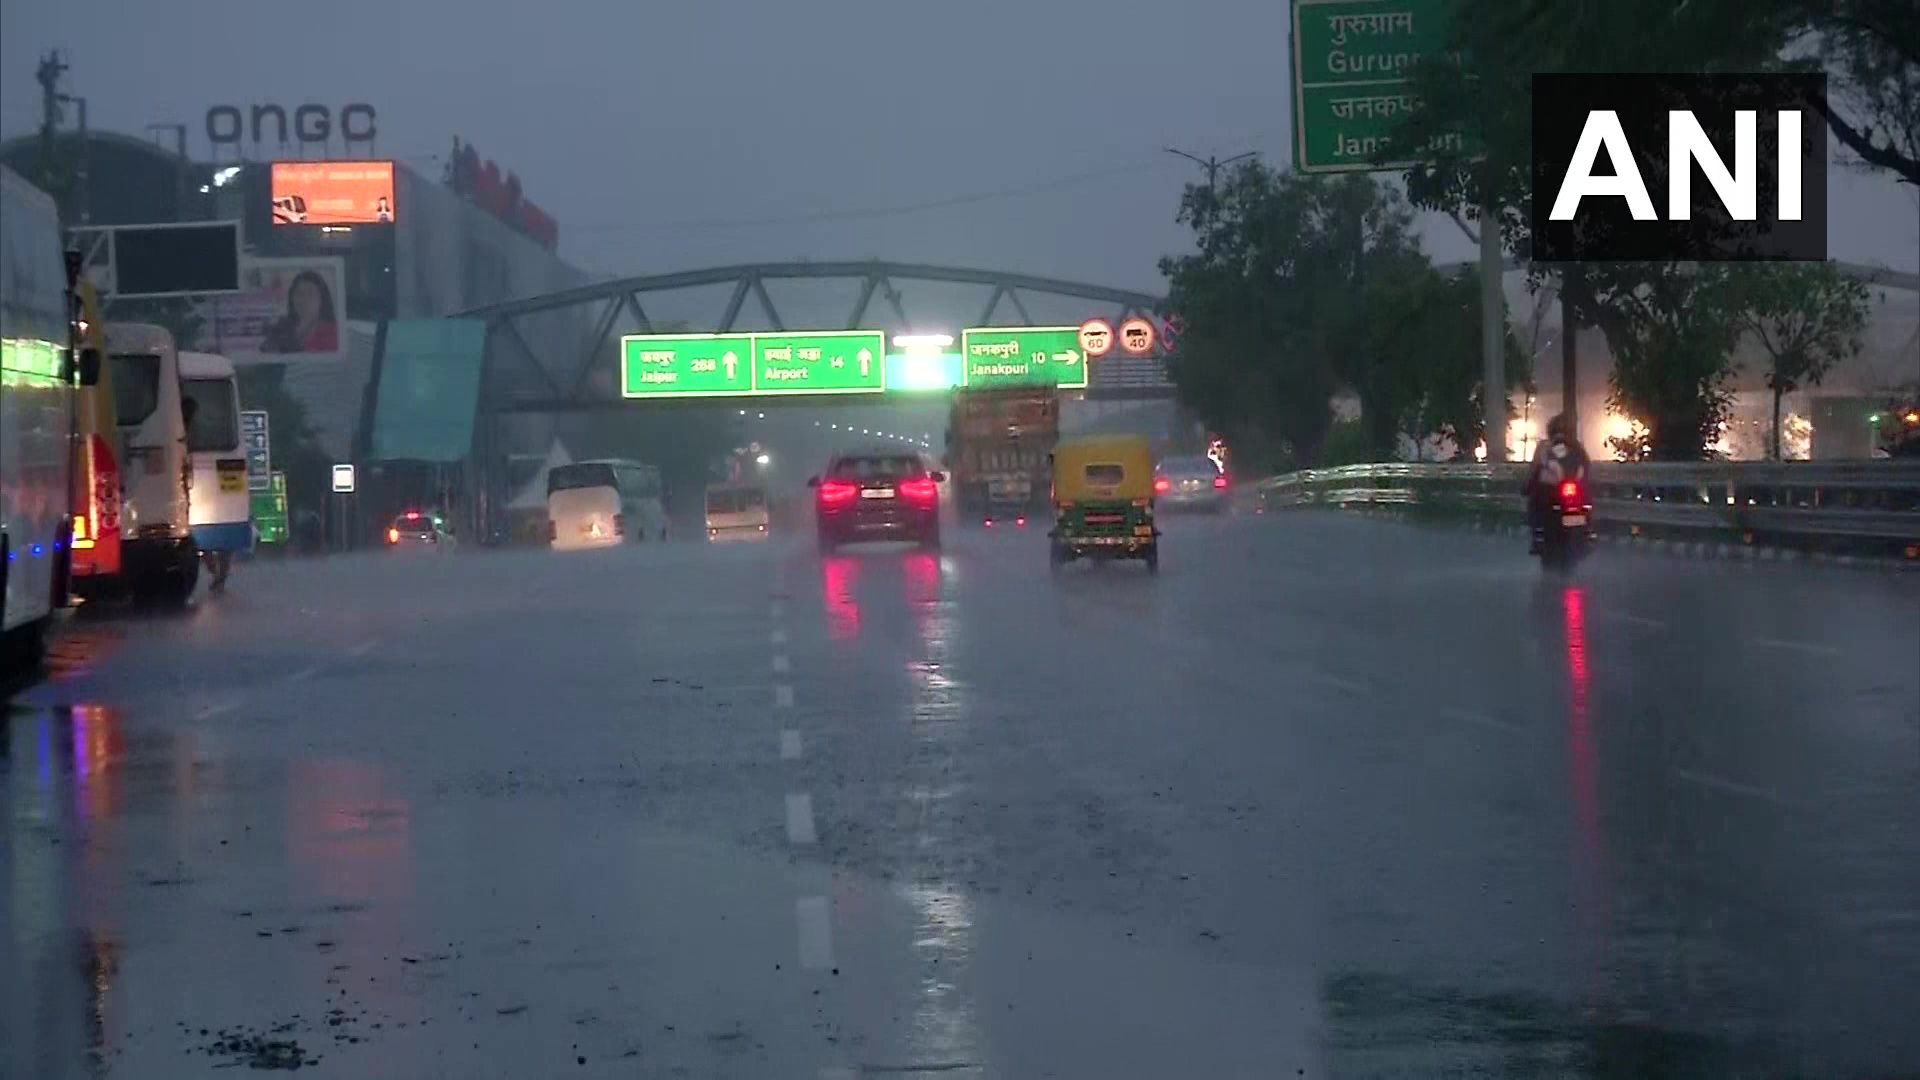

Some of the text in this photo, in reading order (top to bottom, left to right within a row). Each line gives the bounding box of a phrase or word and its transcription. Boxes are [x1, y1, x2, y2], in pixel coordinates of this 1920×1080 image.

[1328, 12, 1413, 45] गुरुग्राम
[1087, 338, 1104, 349] 60
[1129, 338, 1146, 349] 40
[1030, 351, 1046, 365] 10
[764, 367, 809, 381] Airport
[970, 362, 1029, 376] Janakpuri
